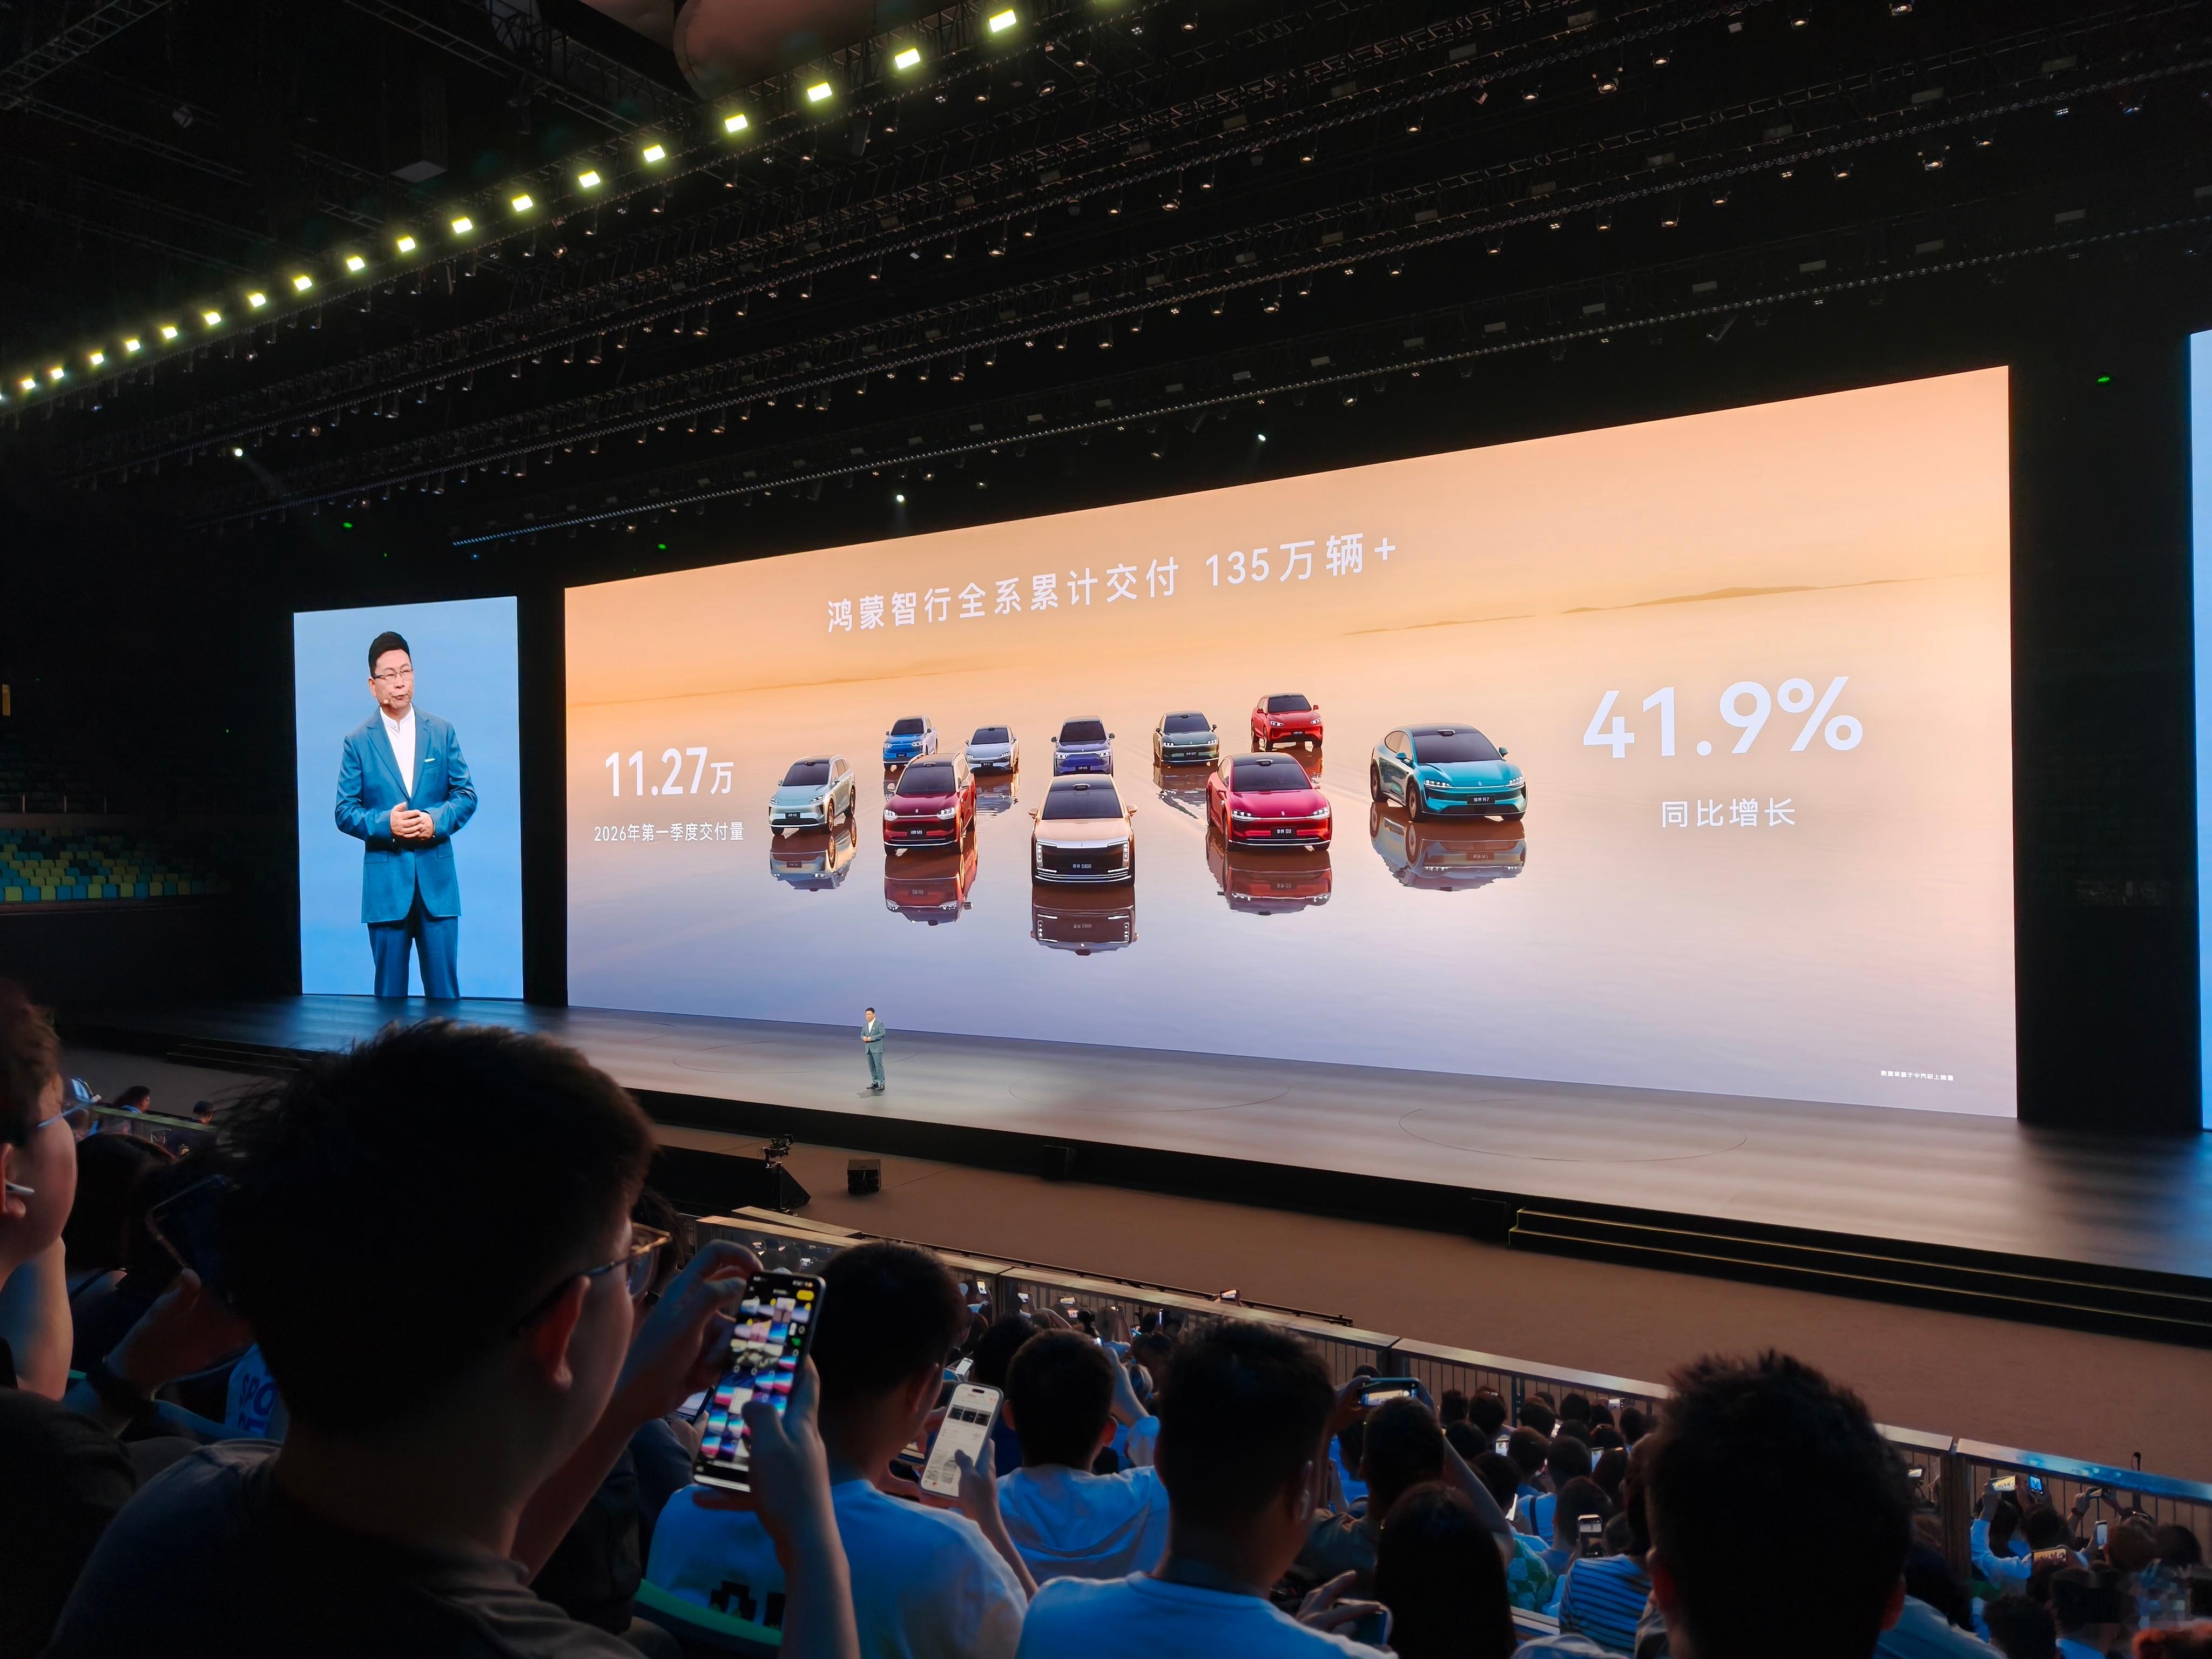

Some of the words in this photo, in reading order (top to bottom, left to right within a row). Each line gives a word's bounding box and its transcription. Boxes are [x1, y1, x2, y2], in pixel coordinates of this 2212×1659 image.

[827, 556, 1179, 633] 鸿蒙智行全系累计交付
[1205, 533, 1397, 587] 135万辆+
[1583, 676, 1864, 759] 41.9%
[605, 746, 734, 797] 11.27万
[594, 821, 744, 842] 2026年第一季度交付量
[1662, 797, 1796, 828] 同比增长
